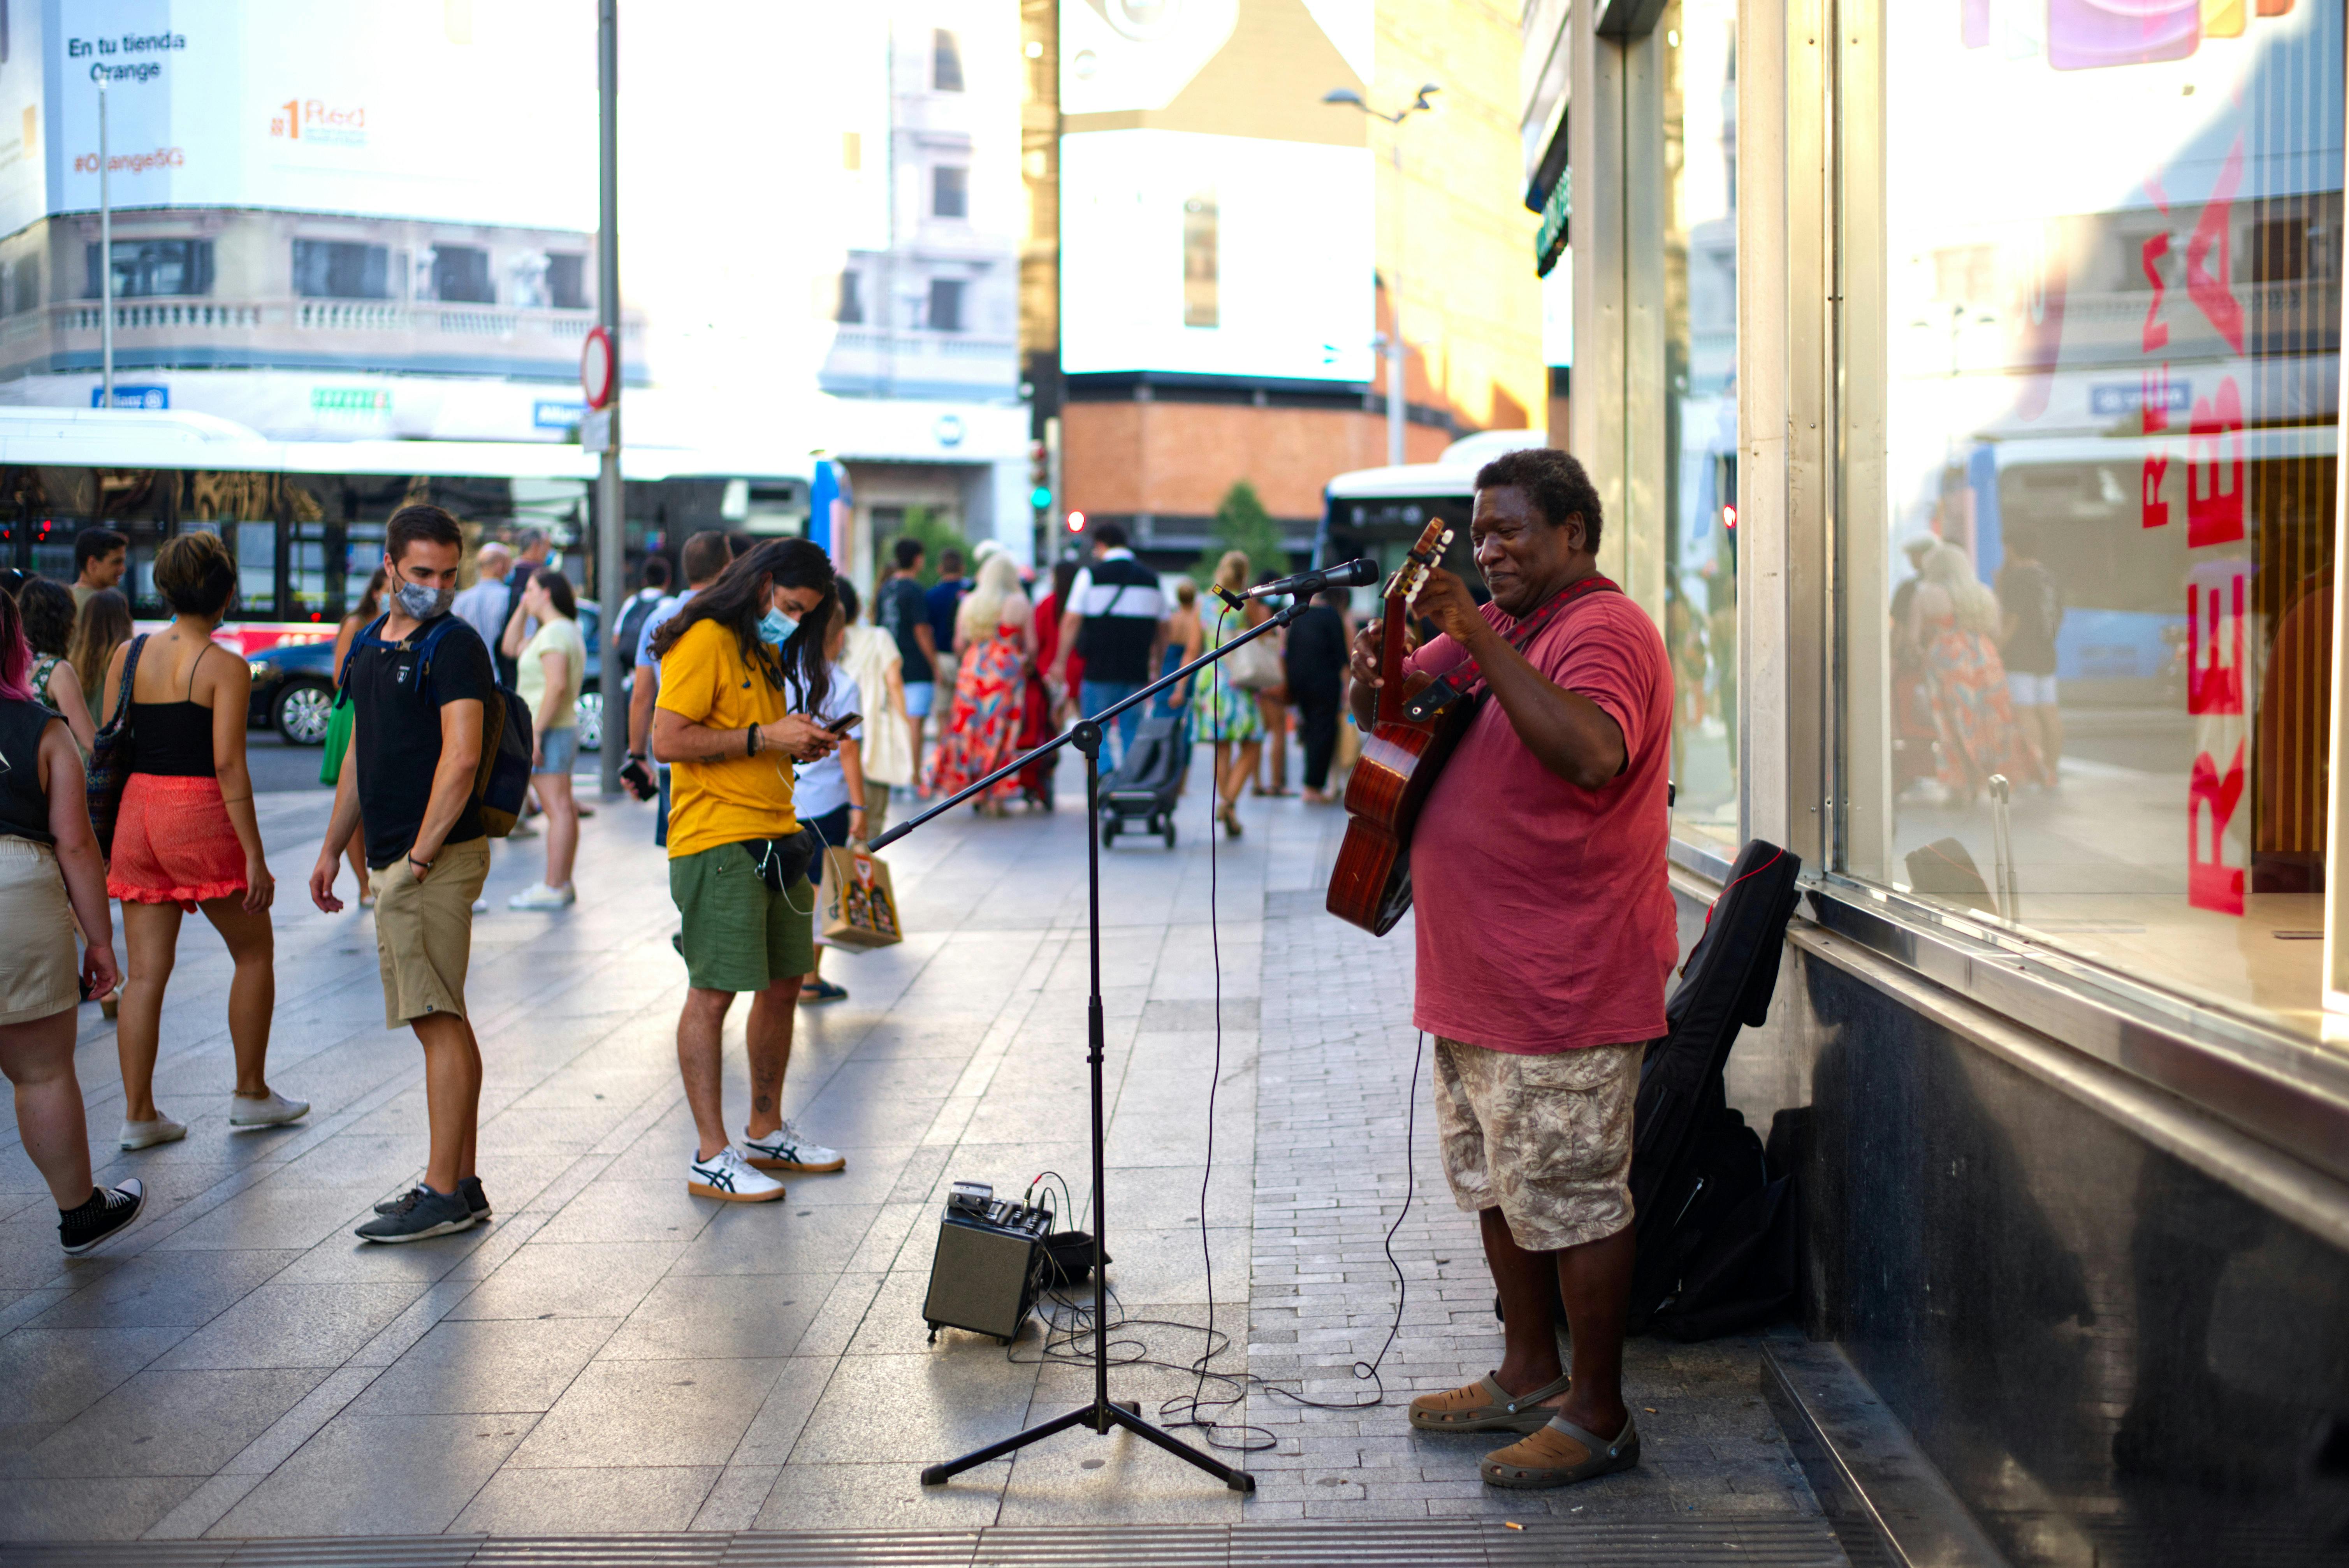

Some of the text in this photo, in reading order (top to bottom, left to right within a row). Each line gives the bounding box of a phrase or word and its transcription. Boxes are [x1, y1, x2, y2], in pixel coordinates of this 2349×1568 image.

[69, 30, 185, 57] En tu tienda
[90, 62, 161, 83] Orange
[73, 147, 184, 175] #Oange5G
